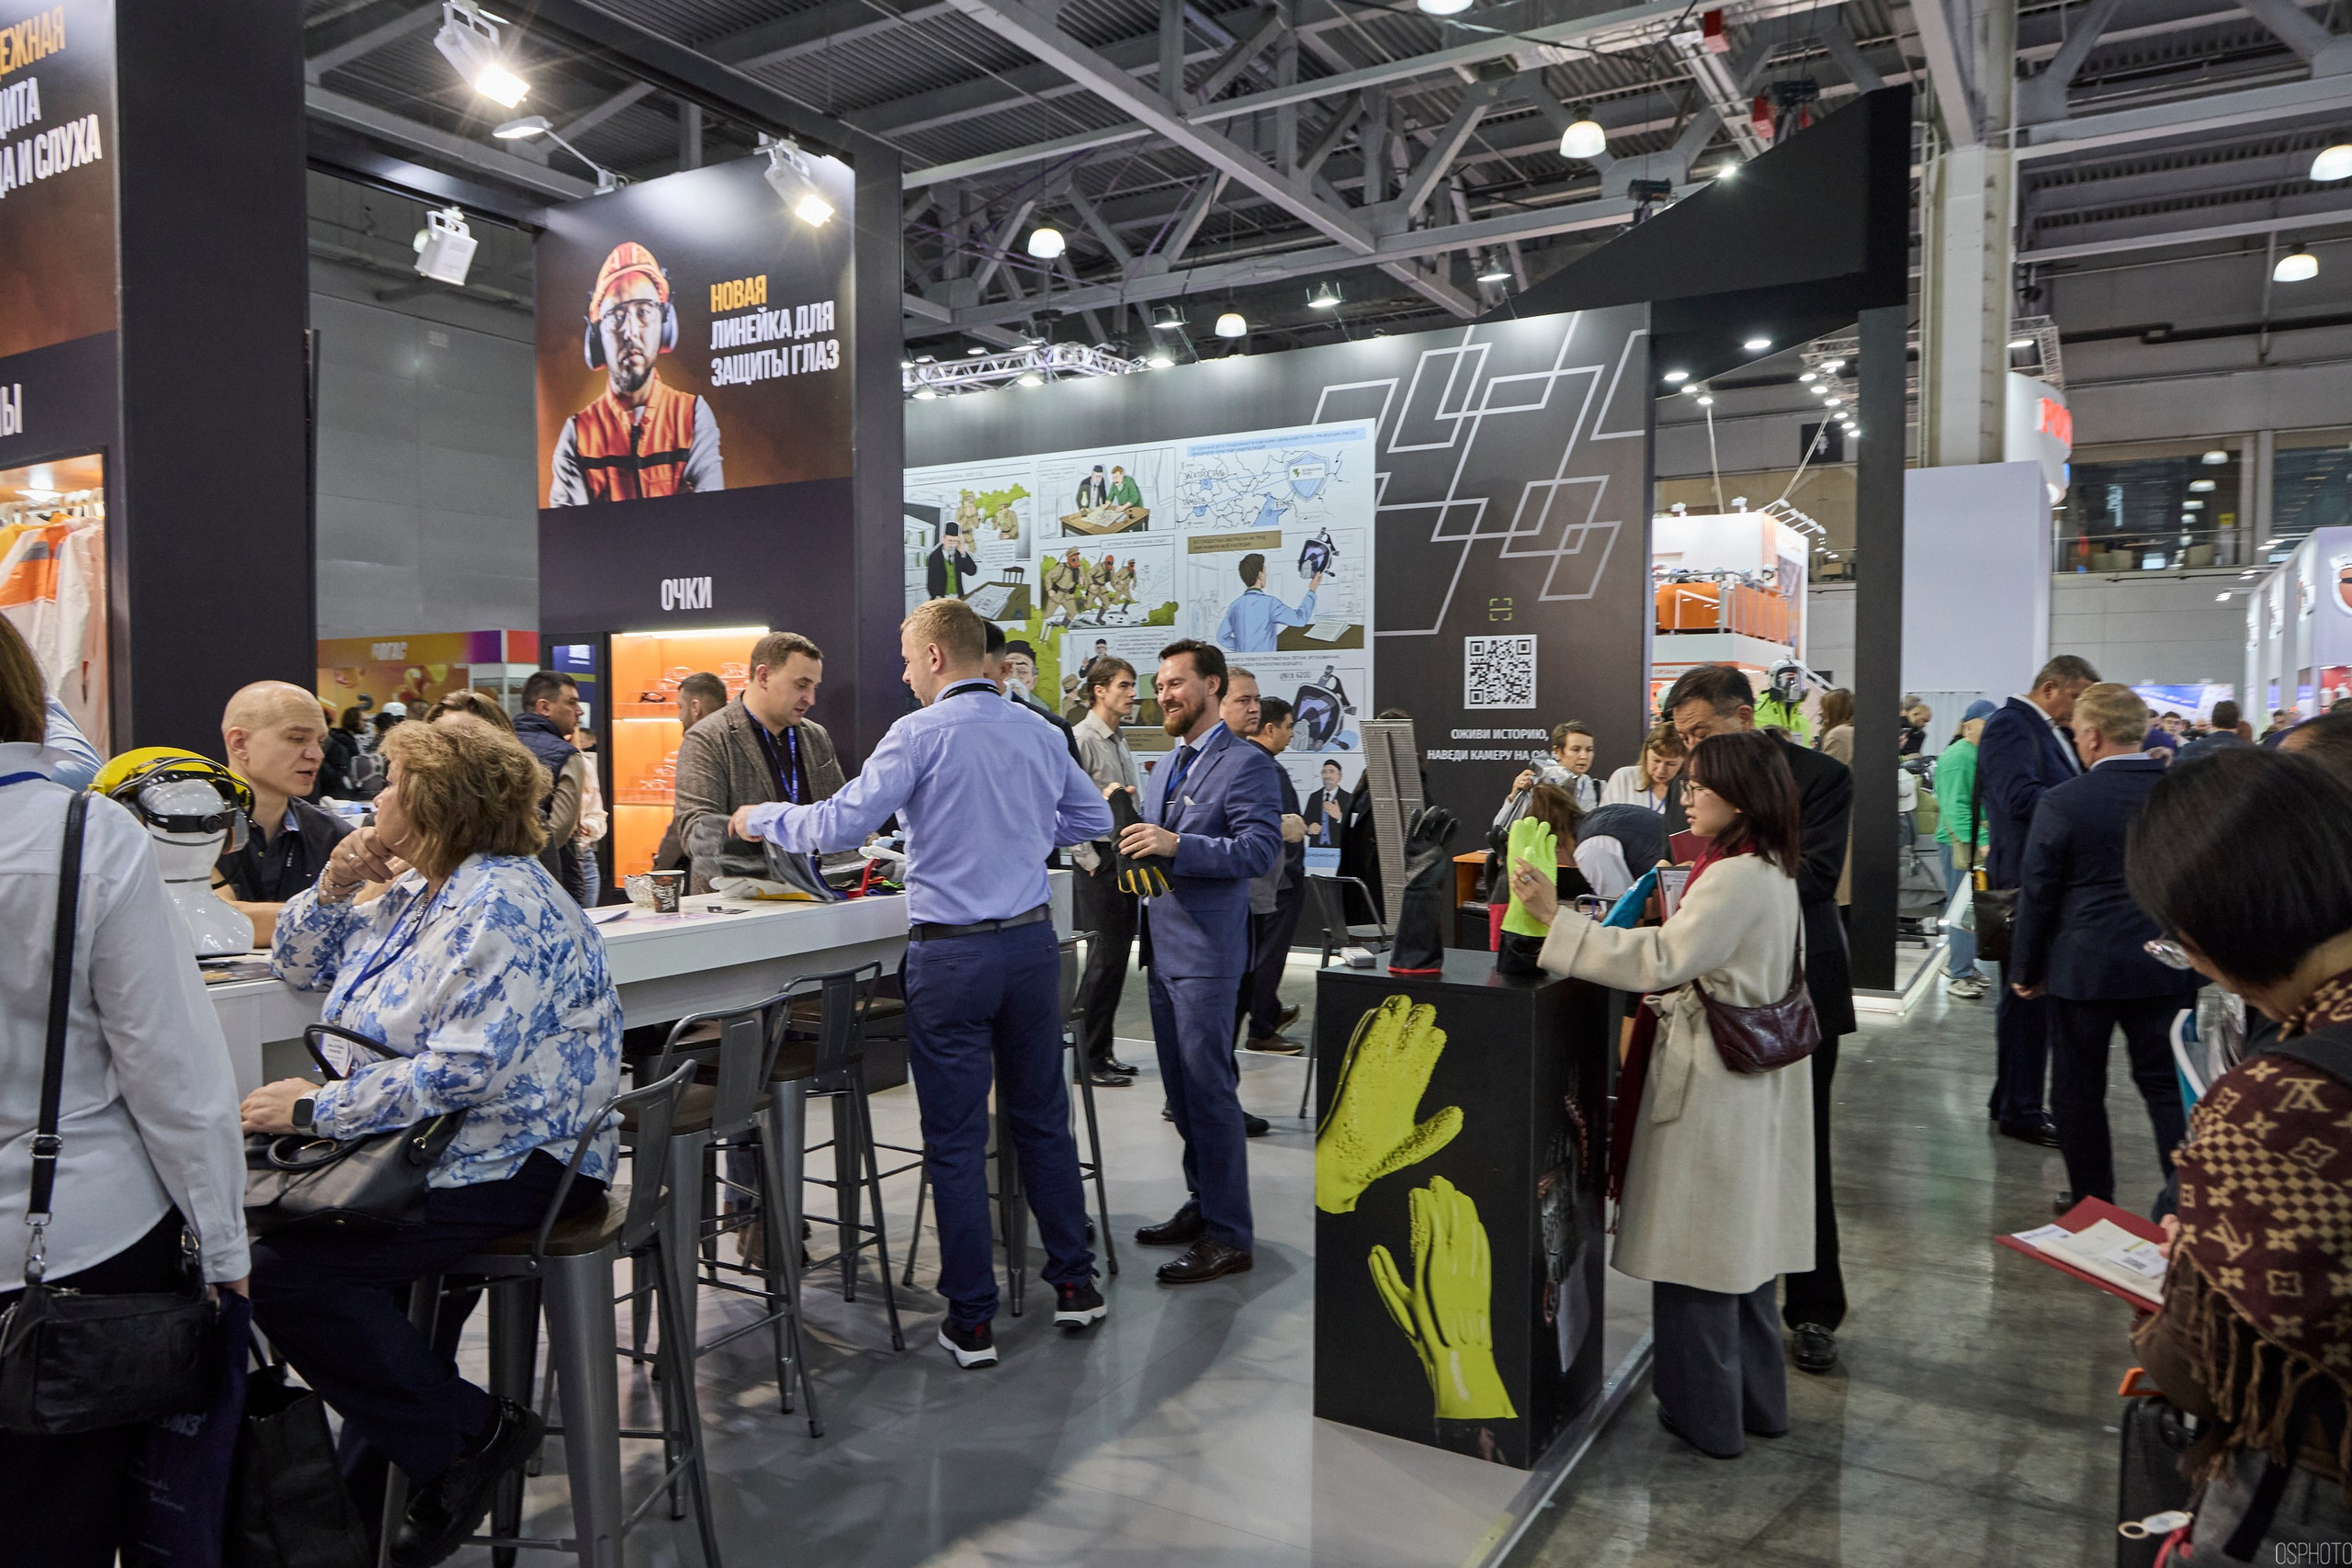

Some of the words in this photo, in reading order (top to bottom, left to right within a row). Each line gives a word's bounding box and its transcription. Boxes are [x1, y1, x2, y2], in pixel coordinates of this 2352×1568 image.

[0, 5, 65, 81] ЕЖНАЯ
[17, 139, 33, 186] И
[34, 113, 103, 180] СЛУХА
[710, 274, 766, 313] НОВАЯ
[709, 306, 793, 350] ЛИНЕЙКА
[793, 300, 835, 340] ДЛЯ
[710, 346, 789, 387] ЗАЩИТЫ
[791, 338, 841, 376] ГЛАЗ
[661, 576, 713, 611] ОЧКИ
[1427, 750, 1469, 762] НАВЕДИ
[1470, 750, 1512, 761] КАМЕРУ
[1513, 750, 1531, 761] НА
[1451, 728, 1490, 739] ОЖИВИ
[1492, 728, 1550, 741] ИСТОРИЮ,
